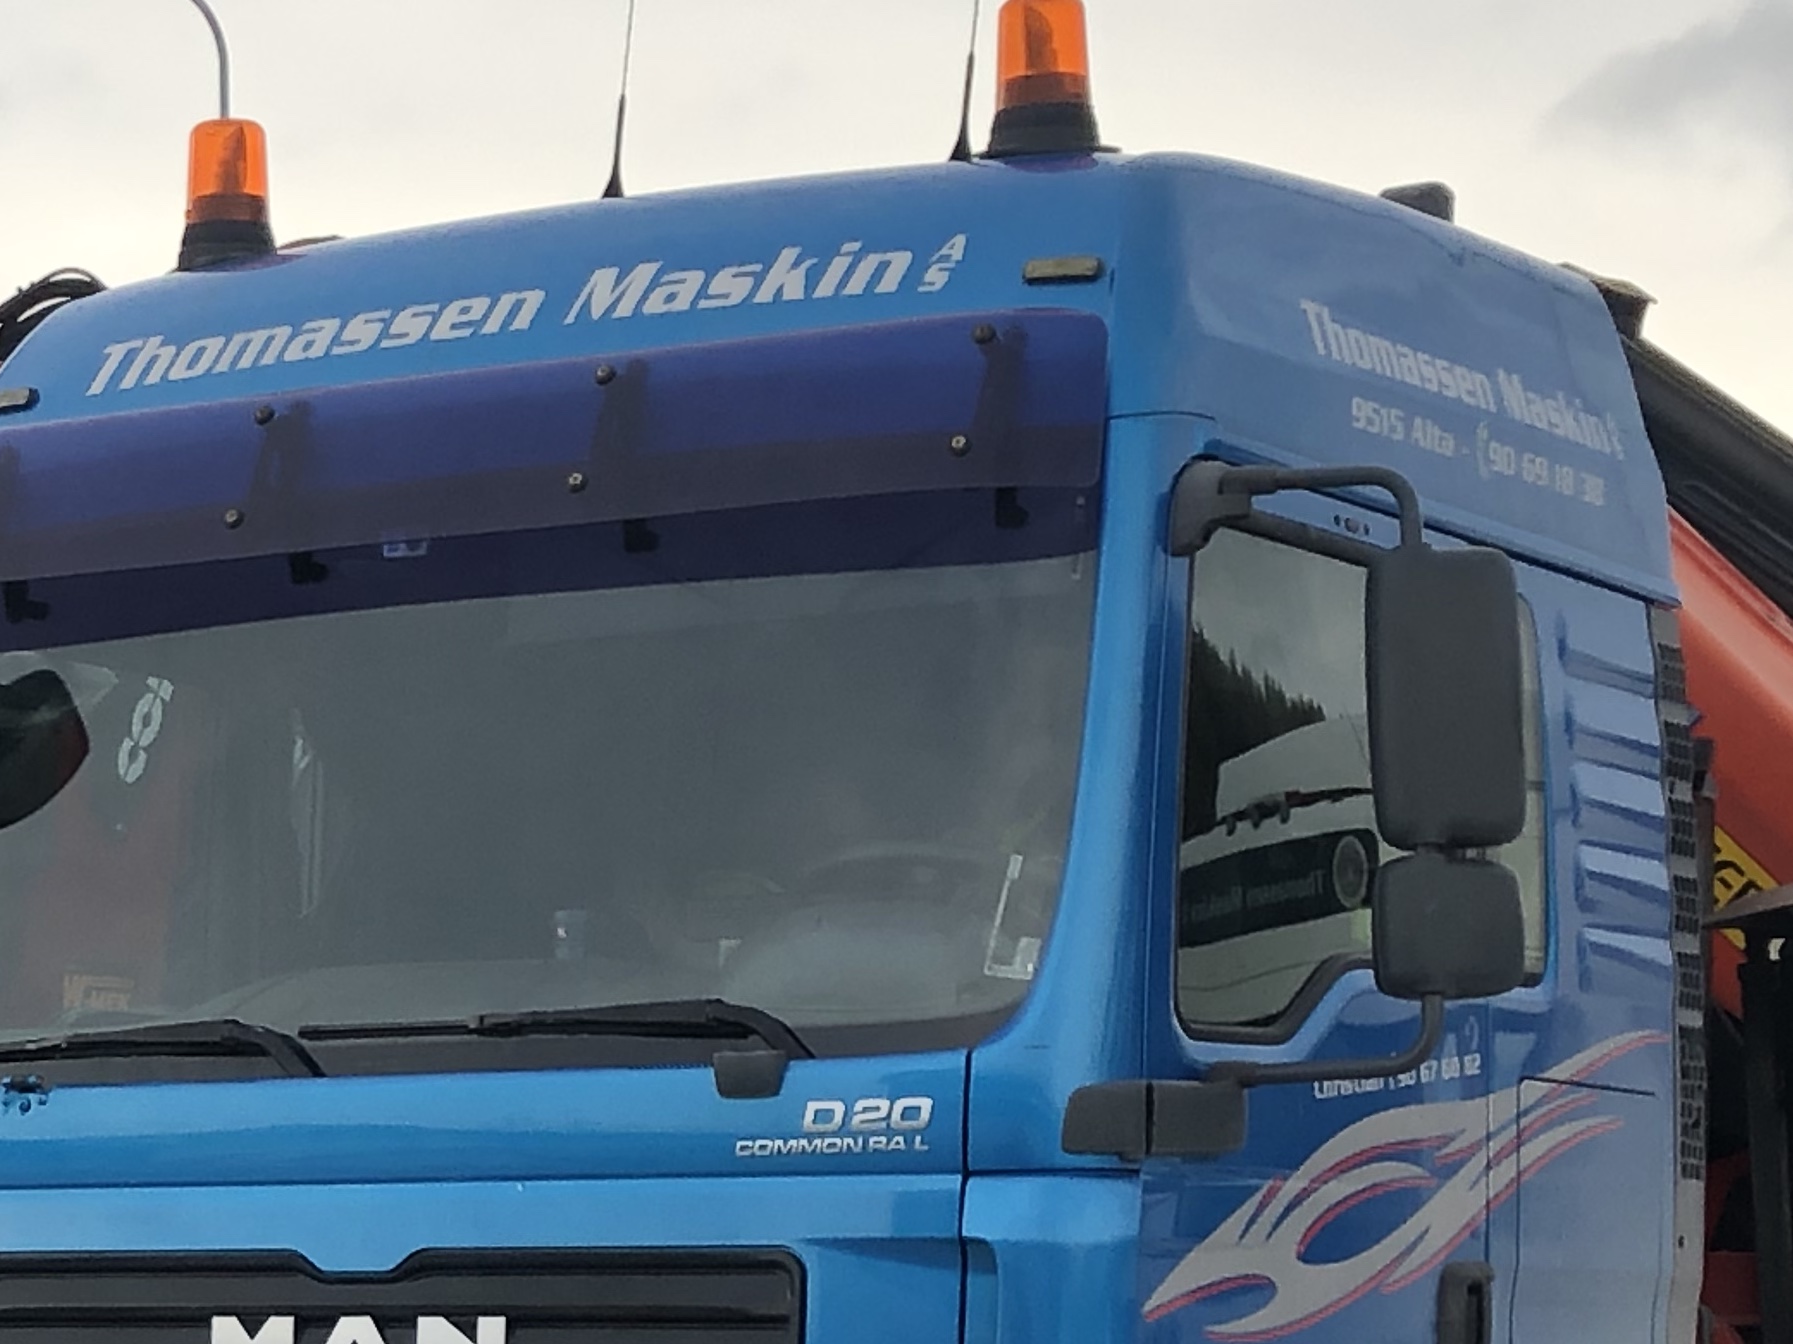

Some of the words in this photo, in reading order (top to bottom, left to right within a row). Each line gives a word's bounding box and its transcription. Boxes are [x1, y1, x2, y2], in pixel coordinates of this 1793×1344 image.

[85, 285, 546, 397] Thomassen
[564, 240, 914, 325] Maskin
[1300, 299, 1497, 414] Thomassen
[1351, 396, 1406, 442] 9515
[1411, 415, 1456, 457] Alta
[1487, 440, 1516, 476] 90
[734, 1136, 864, 1157] COMMON
[803, 1096, 935, 1133] D20
